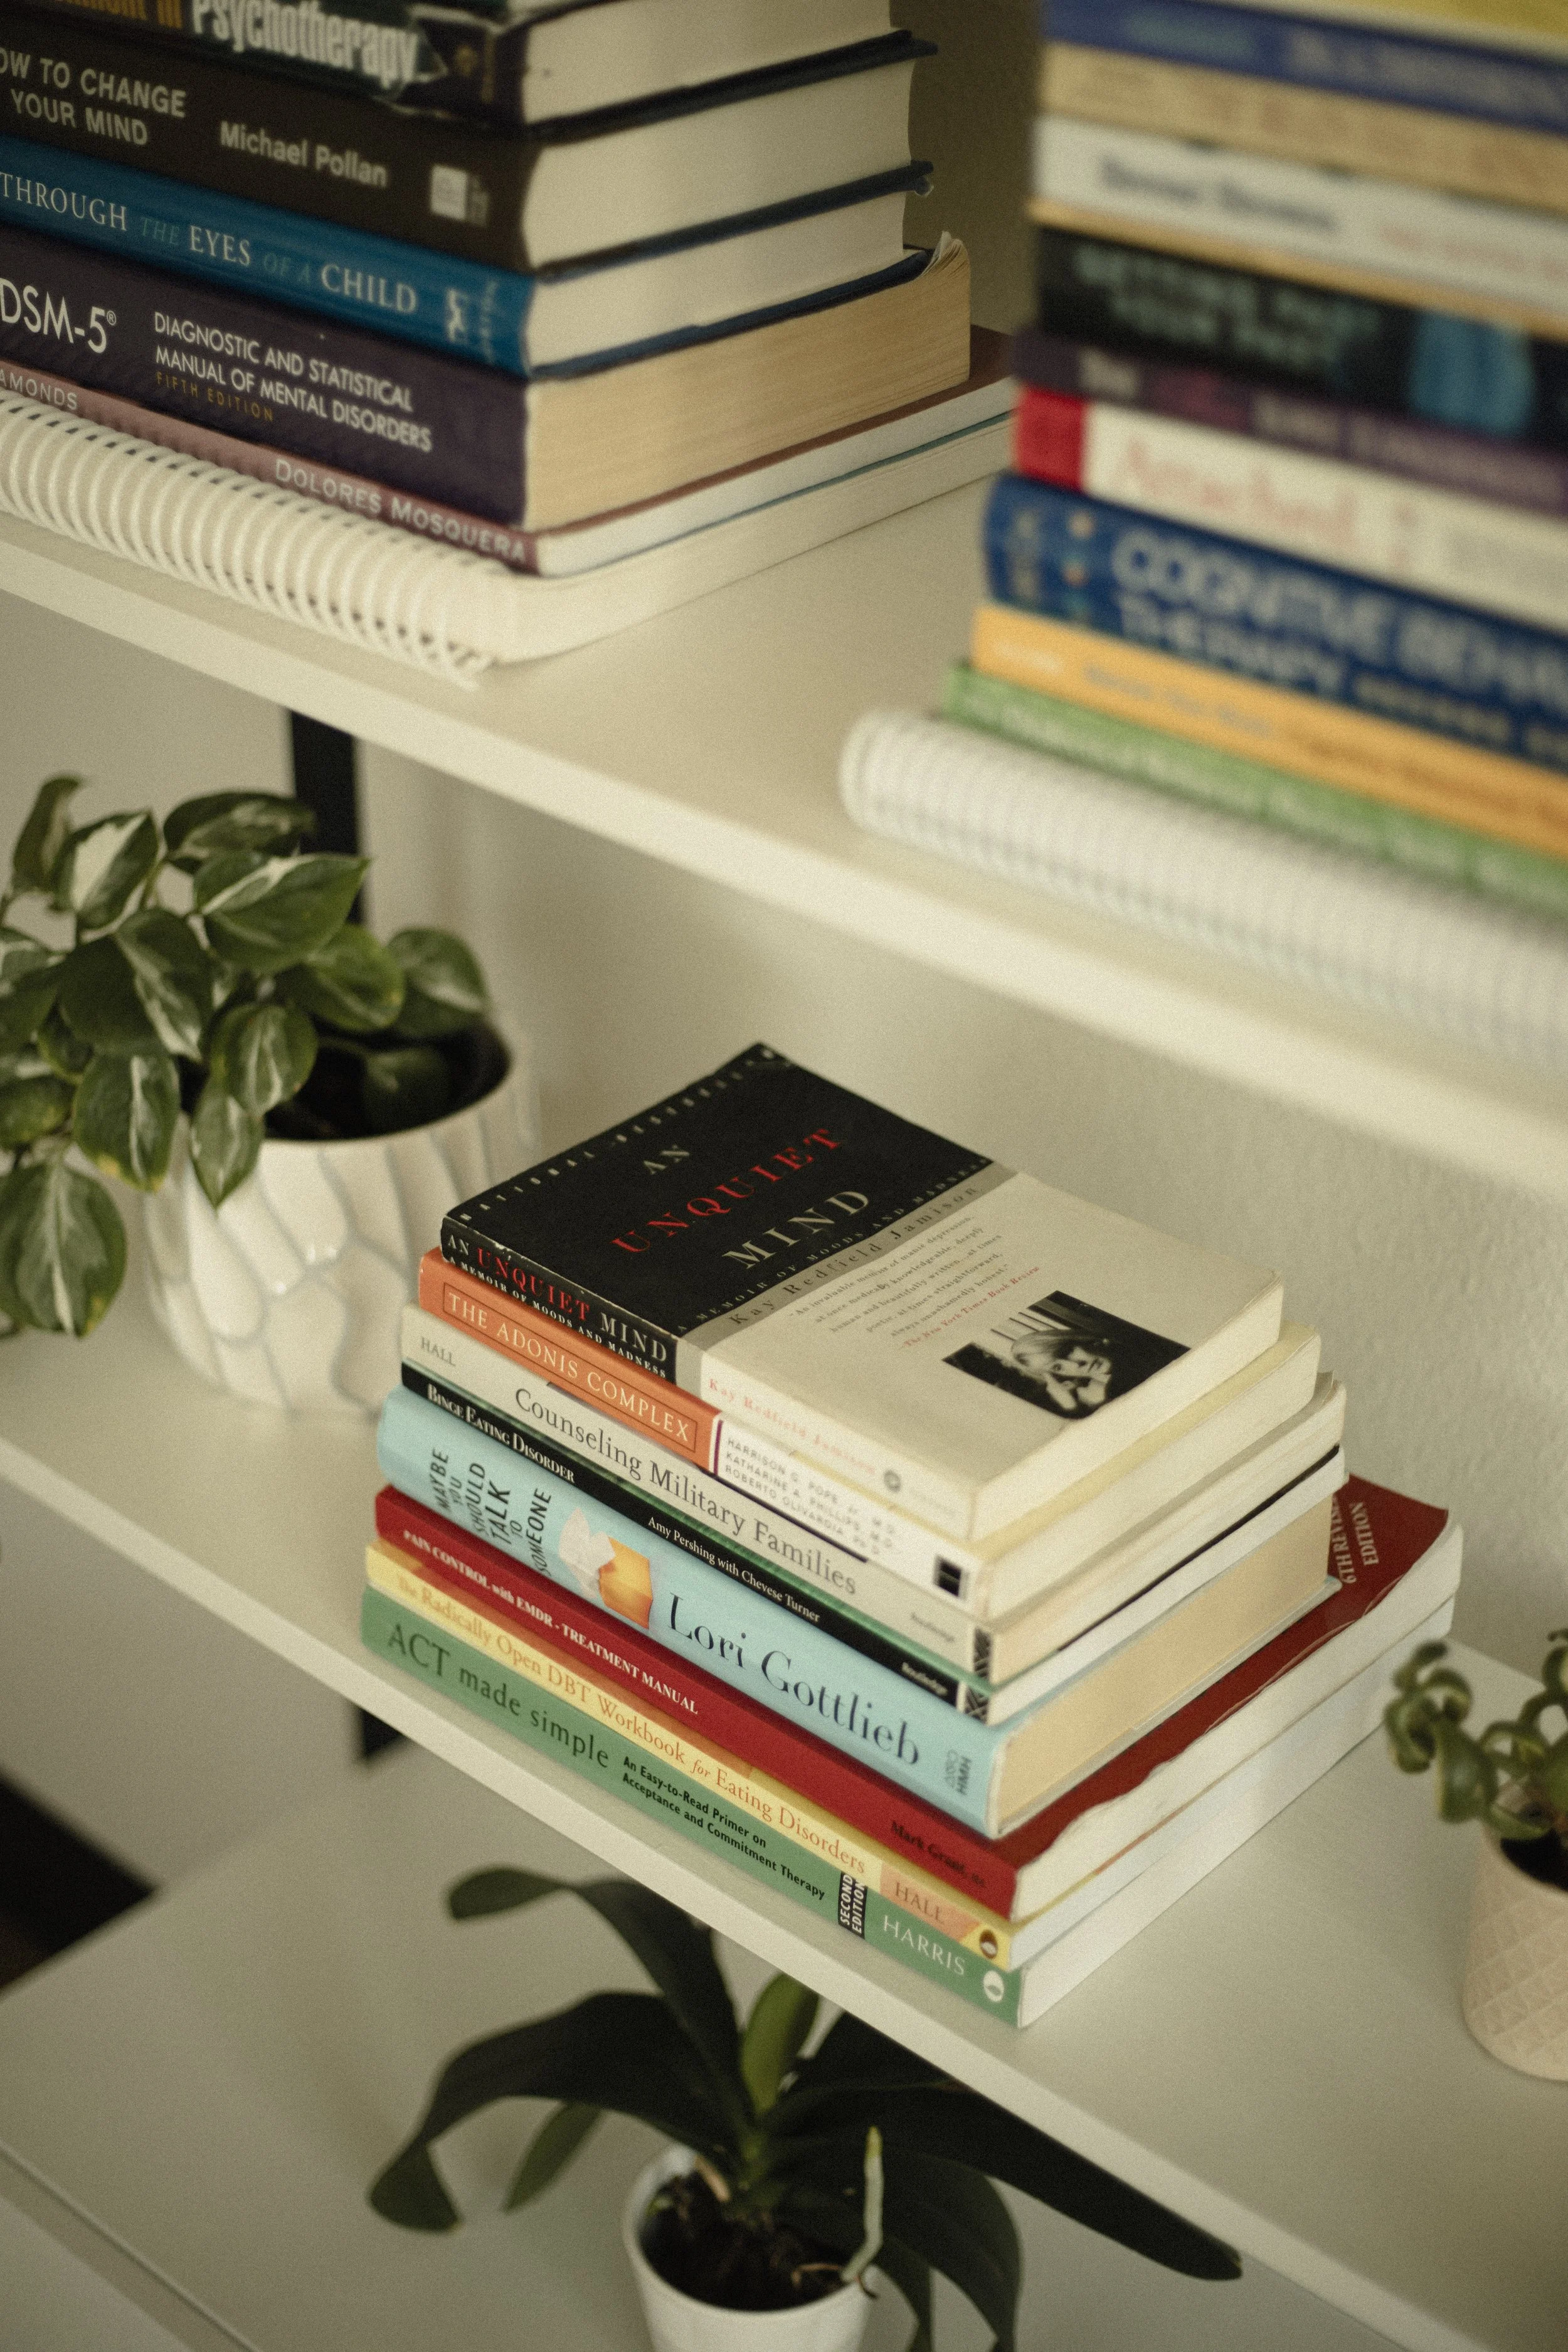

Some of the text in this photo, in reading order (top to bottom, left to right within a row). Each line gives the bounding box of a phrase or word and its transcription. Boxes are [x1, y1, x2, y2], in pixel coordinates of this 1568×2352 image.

[11, 88, 149, 146] YOUR MIND
[40, 57, 70, 89] TO
[80, 68, 187, 119] CHANGE
[220, 120, 388, 188] Michael Pollan
[0, 171, 418, 314] THROUGH THE EYES OF A CHILD
[154, 312, 414, 413] DIAGNOSTIC AND STATISTICAL
[156, 345, 433, 453] MANUAL OF MENTAL DISORDERS
[157, 371, 274, 422] FIFTH EDITION
[610, 1128, 842, 1253] UNQUIET
[644, 1144, 690, 1175] AN
[722, 1191, 869, 1270] MIND
[729, 1186, 978, 1327] Kay Redfield Jamison
[956, 1227, 983, 1245] deeply
[696, 1281, 768, 1321] MEMOIR
[776, 1264, 797, 1278] OF
[807, 1232, 864, 1261] MOODS
[872, 1208, 904, 1229] AND
[810, 1281, 855, 1308] invaluable
[889, 1259, 899, 1268] of
[862, 1304, 879, 1315] and
[880, 1278, 928, 1306] beautifully
[976, 1234, 1002, 1250] times
[941, 1313, 962, 1327] York
[961, 1296, 988, 1314] Times
[988, 1283, 1010, 1298] Book
[1010, 1266, 1040, 1285] Review
[447, 1234, 667, 1362] AN UNQUIET MIND
[461, 1261, 507, 1291] MEMOIR
[512, 1290, 527, 1302] OF
[533, 1300, 573, 1328] MOODS
[578, 1326, 602, 1344] AND
[608, 1341, 666, 1379] MADNESS
[908, 1293, 933, 1310] times
[420, 1336, 457, 1367] HALL
[448, 1291, 689, 1442] THE ADONIS COMPLEX
[429, 1448, 450, 1510] MAYBE
[725, 1464, 777, 1499] ROBERTO
[728, 1437, 785, 1475] HARRISON
[449, 1476, 462, 1505] YOU
[465, 1463, 489, 1536] SHOULD
[485, 1480, 512, 1545] TALK
[514, 1387, 643, 1481] Counseling
[649, 1461, 745, 1536] Military
[752, 1518, 857, 1596] Families
[509, 1520, 523, 1539] TO
[526, 1488, 552, 1577] SOMEONE
[1350, 1502, 1379, 1565] EDITION
[648, 1517, 820, 1623] Amy Pershing with Chevese Turner
[1335, 1553, 1357, 1584] 6TH
[403, 1530, 698, 1715] PAIN CONTROL with EMDR TREATMENT MANUAL
[388, 1623, 610, 1769] ACT made simple
[668, 1591, 919, 1766] Lori Gottlieb
[421, 1586, 492, 1647] Radically
[496, 1634, 543, 1675] Open
[548, 1665, 591, 1703] DBT
[598, 1694, 686, 1764] Workbook
[691, 1759, 711, 1778] for
[716, 1766, 772, 1822] Eating
[778, 1805, 866, 1874] Disorders
[623, 1756, 766, 1848] An Easy-to-Read Primer on
[891, 1820, 924, 1850] Mark
[623, 1772, 825, 1900] Acceptance and Commitment Therapy
[840, 1873, 854, 1926] SECOND
[852, 1880, 866, 1934] EDITION
[895, 1882, 945, 1924] HALL
[883, 1914, 967, 1976] HARRIS
